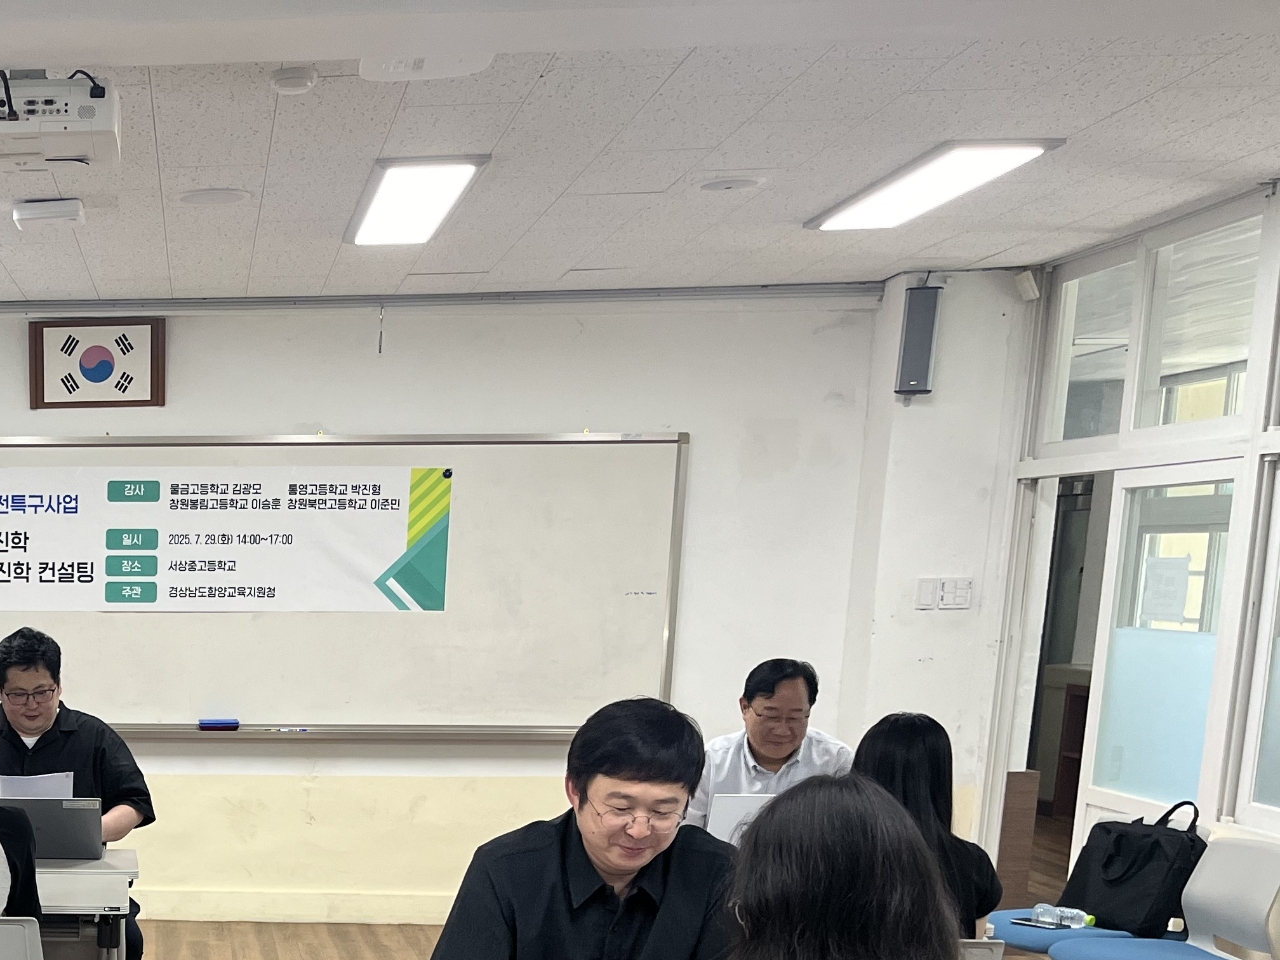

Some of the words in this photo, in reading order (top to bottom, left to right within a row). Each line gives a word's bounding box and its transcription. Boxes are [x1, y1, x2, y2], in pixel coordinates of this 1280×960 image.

[124, 484, 144, 496] 강사
[170, 483, 229, 495] 물금고등학교
[232, 483, 262, 495] 김광모
[288, 484, 348, 496] 통영고등학교
[351, 484, 381, 496] 박진형
[169, 498, 248, 510] 창원봉림고등학교
[251, 498, 281, 510] 이승훈
[287, 498, 367, 510] 창원북면고등학교
[370, 498, 400, 510] 이준민
[122, 533, 142, 546] 일시
[168, 533, 192, 545] 2025.
[195, 533, 202, 545] 7.
[236, 533, 293, 545] 14:00~17:00
[38, 561, 94, 583] 컨설팅
[121, 560, 141, 572] 장소
[168, 560, 236, 572] 서상중고등학교
[121, 586, 142, 598] 주관
[168, 586, 276, 598] 경상남도함양교육지원청
